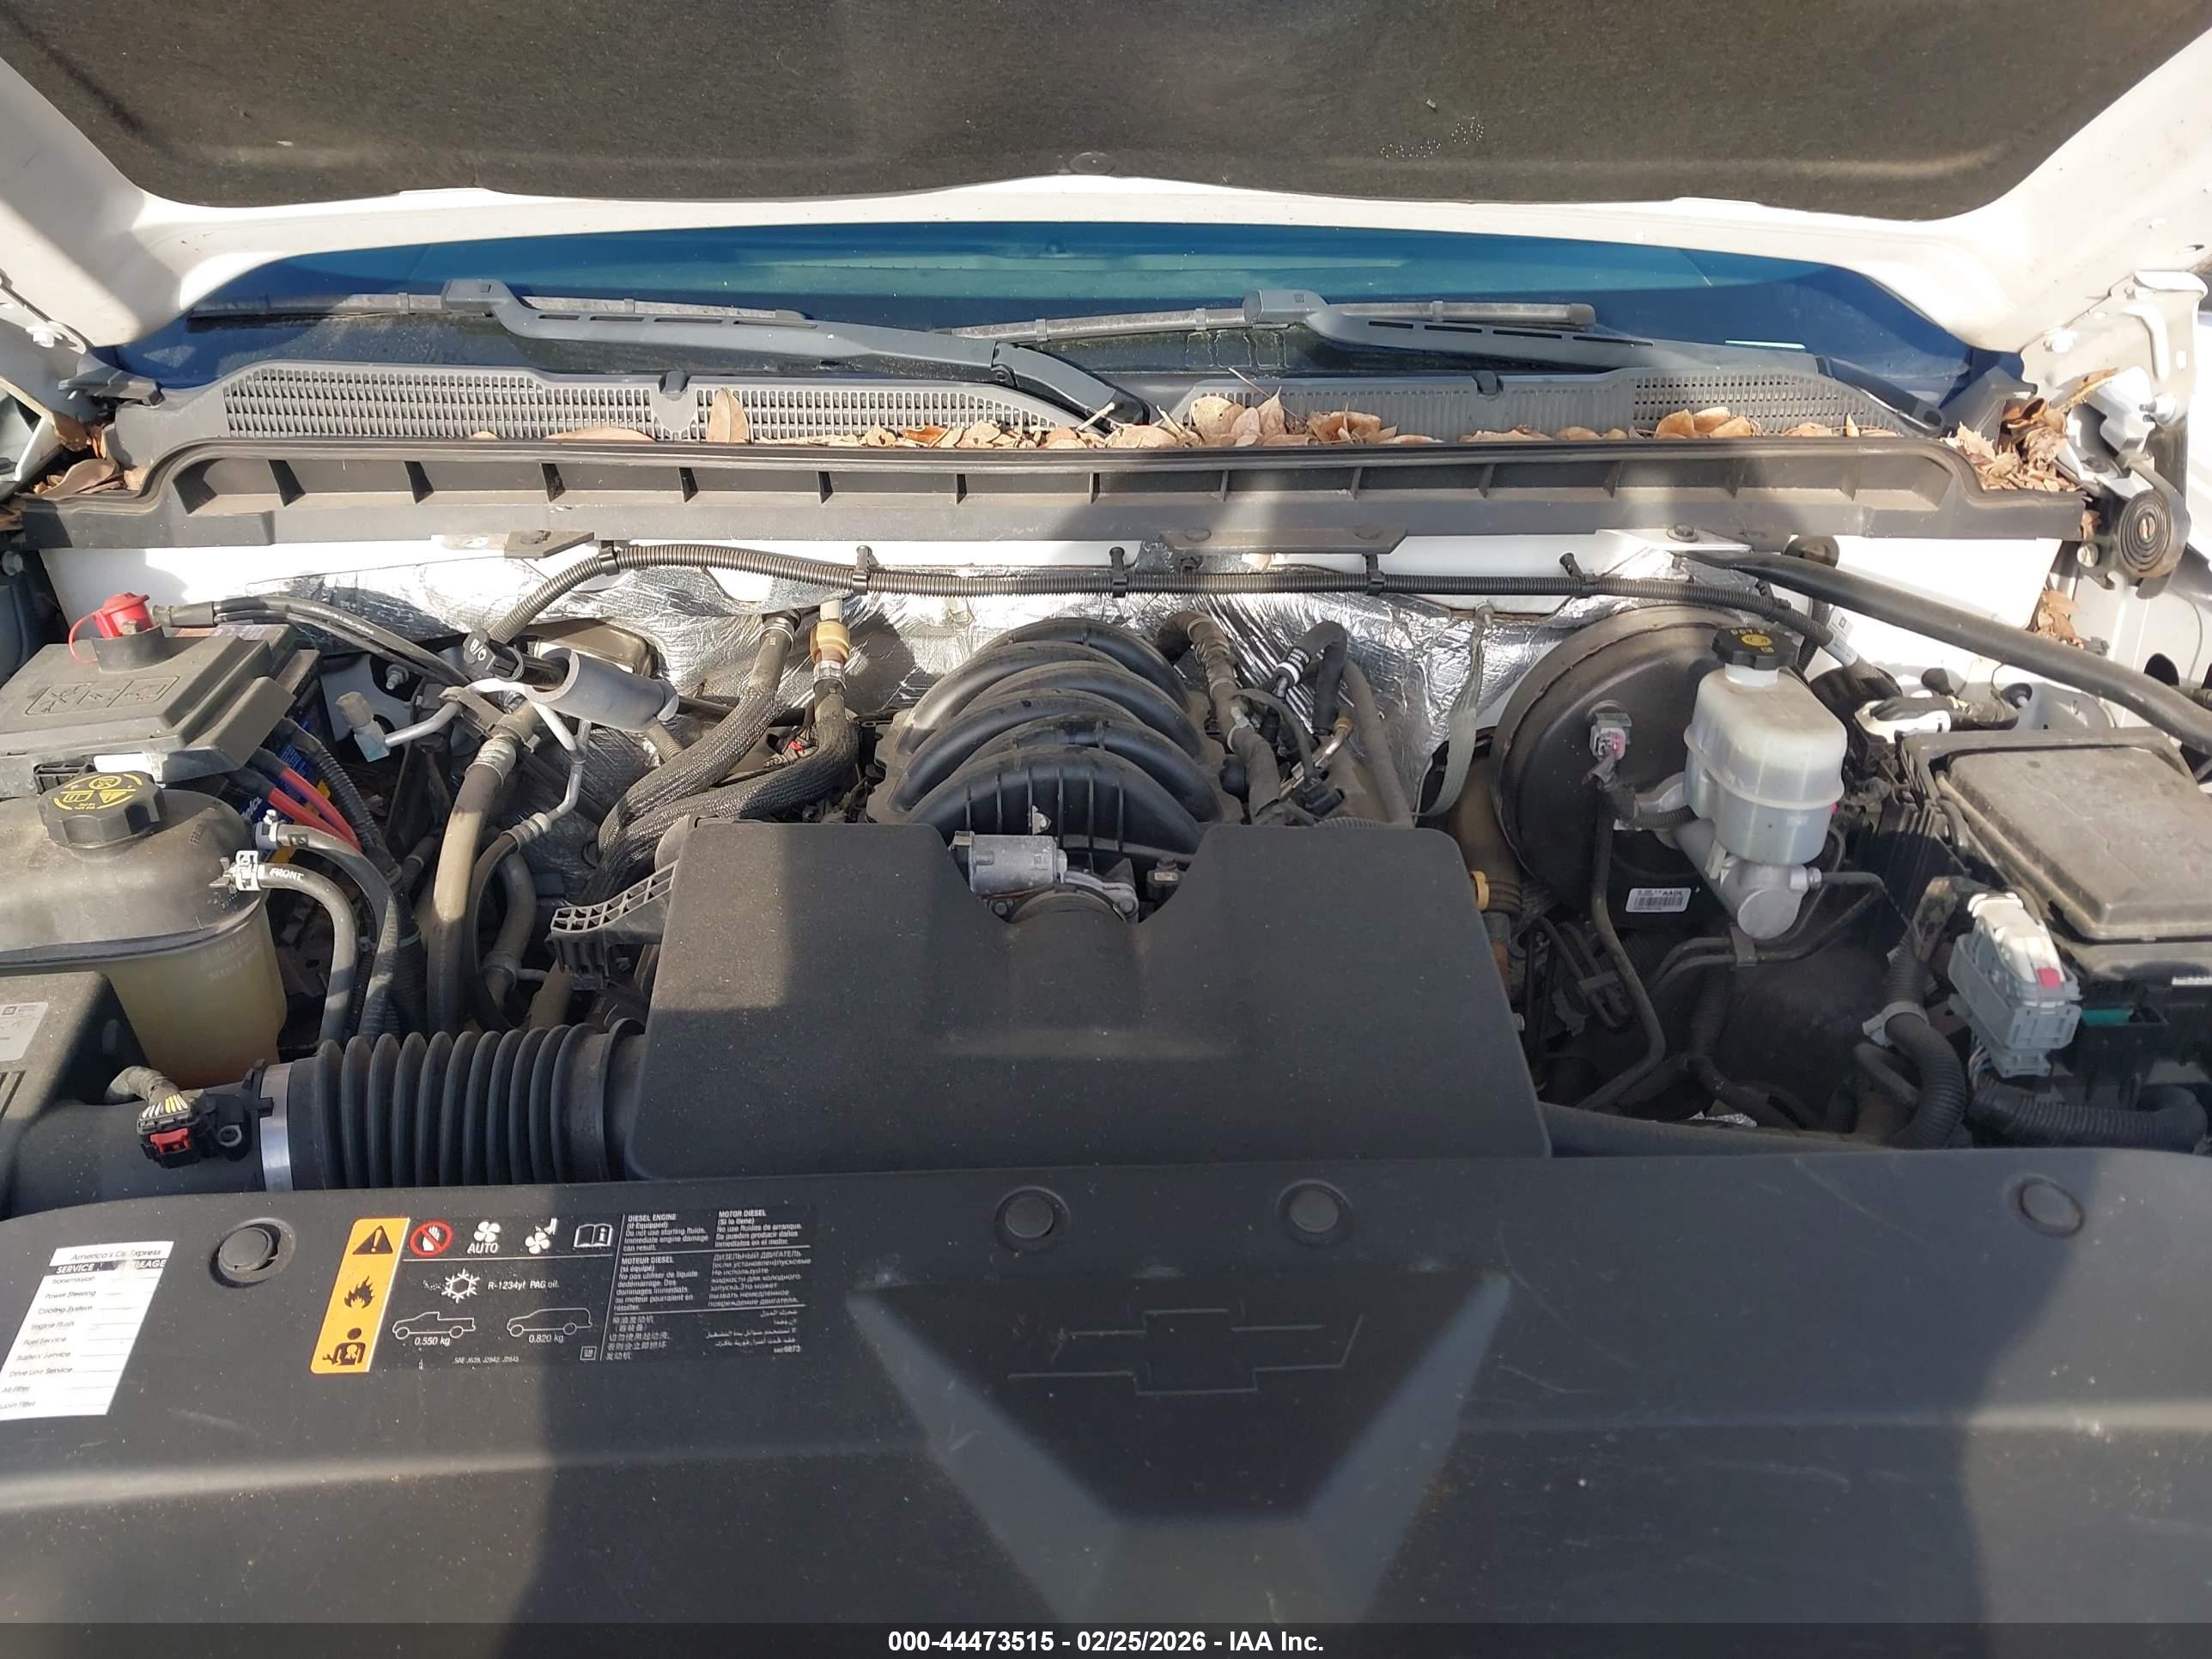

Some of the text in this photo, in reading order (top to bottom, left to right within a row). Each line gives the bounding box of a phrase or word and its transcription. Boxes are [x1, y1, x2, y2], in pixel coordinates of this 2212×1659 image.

[269, 867, 305, 881] FRONT
[628, 1212, 677, 1223] DIESEL ENGINE
[660, 1228, 685, 1237] starting
[659, 1236, 682, 1244] engine
[683, 1234, 708, 1243] damage
[467, 1243, 498, 1254] AUTO
[621, 1256, 649, 1265] MOTEUR
[56, 1262, 95, 1275] SERVICE
[530, 1279, 547, 1290] PAG
[415, 1335, 451, 1346] 0.550 kg
[528, 1332, 564, 1345] 0.820 kg
